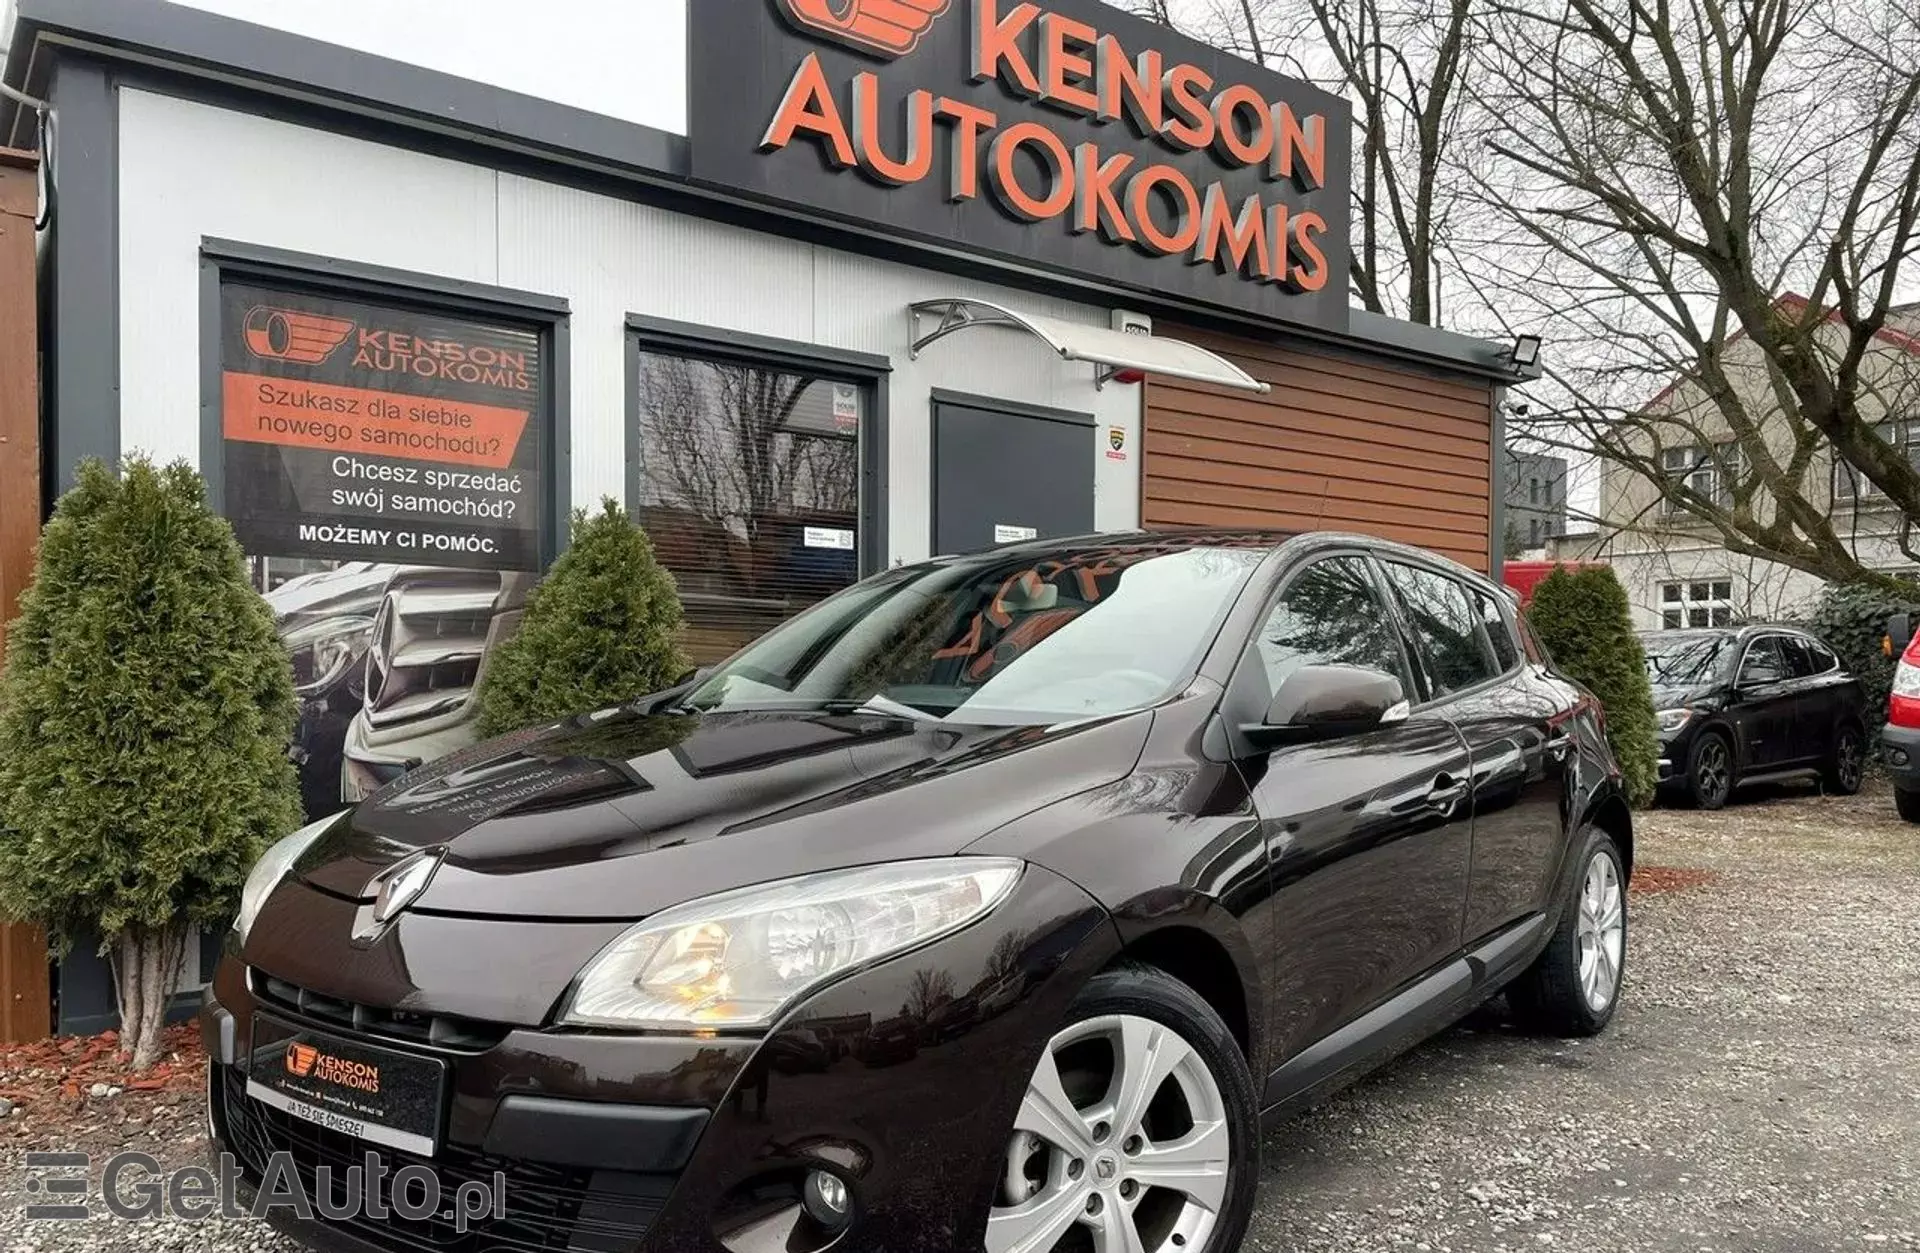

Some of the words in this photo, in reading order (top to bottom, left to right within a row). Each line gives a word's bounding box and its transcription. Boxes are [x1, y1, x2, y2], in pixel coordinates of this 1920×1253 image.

[972, 0, 1325, 190] KENSON
[760, 51, 1328, 291] AUTOKOMIS
[352, 348, 528, 390] AUTOKOMIS
[359, 328, 525, 371] KENSON
[258, 384, 360, 415] Szukasz
[367, 399, 401, 420] dla
[409, 406, 472, 429] siebie
[258, 415, 352, 443] nowego
[360, 427, 501, 456] samochodu?
[332, 456, 418, 484] Chcesz
[425, 470, 522, 494] sprzedać
[332, 487, 384, 513] swój
[391, 495, 516, 519] samochód?
[299, 524, 391, 546] MOŻEMY
[396, 532, 416, 548] CI
[422, 534, 499, 554] POMÓC.
[314, 1067, 379, 1093] AUTOKOMIS
[317, 1053, 378, 1080] KENSON
